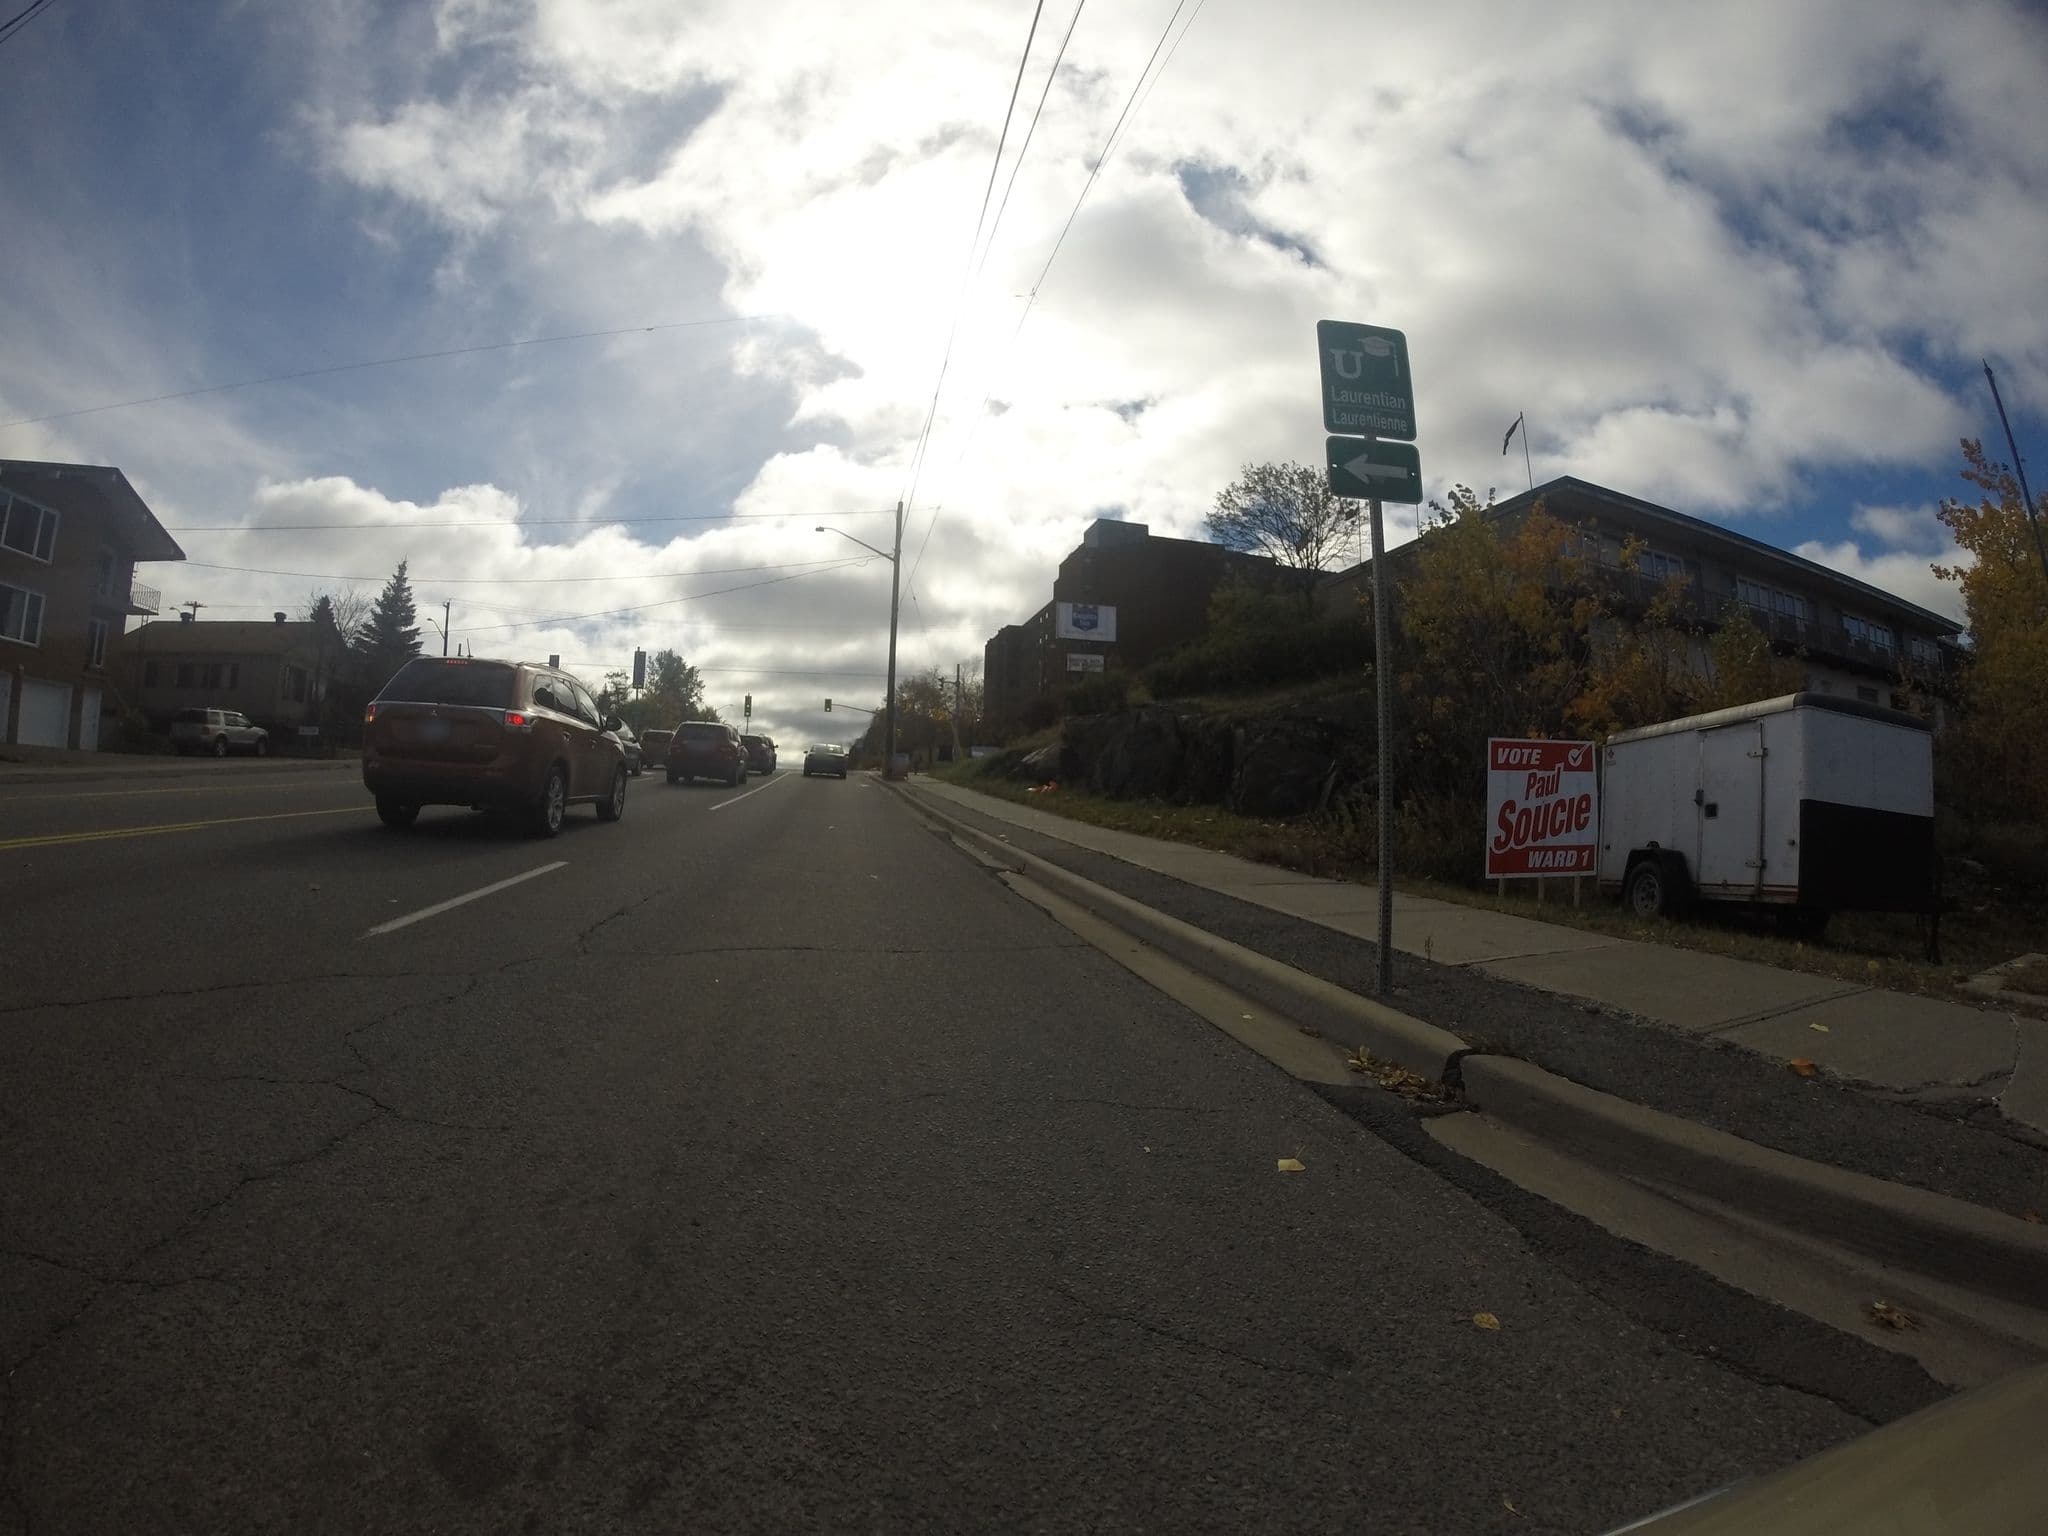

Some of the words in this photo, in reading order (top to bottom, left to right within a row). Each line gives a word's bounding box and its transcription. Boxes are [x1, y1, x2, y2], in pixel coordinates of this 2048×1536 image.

[1329, 348, 1364, 379] U
[1331, 385, 1406, 410] Laurentian
[1332, 408, 1408, 432] Laurentienne
[1497, 747, 1542, 765] VOTE
[1525, 766, 1562, 800] Paul
[1528, 850, 1578, 868] WARD
[1581, 850, 1590, 867] 1
